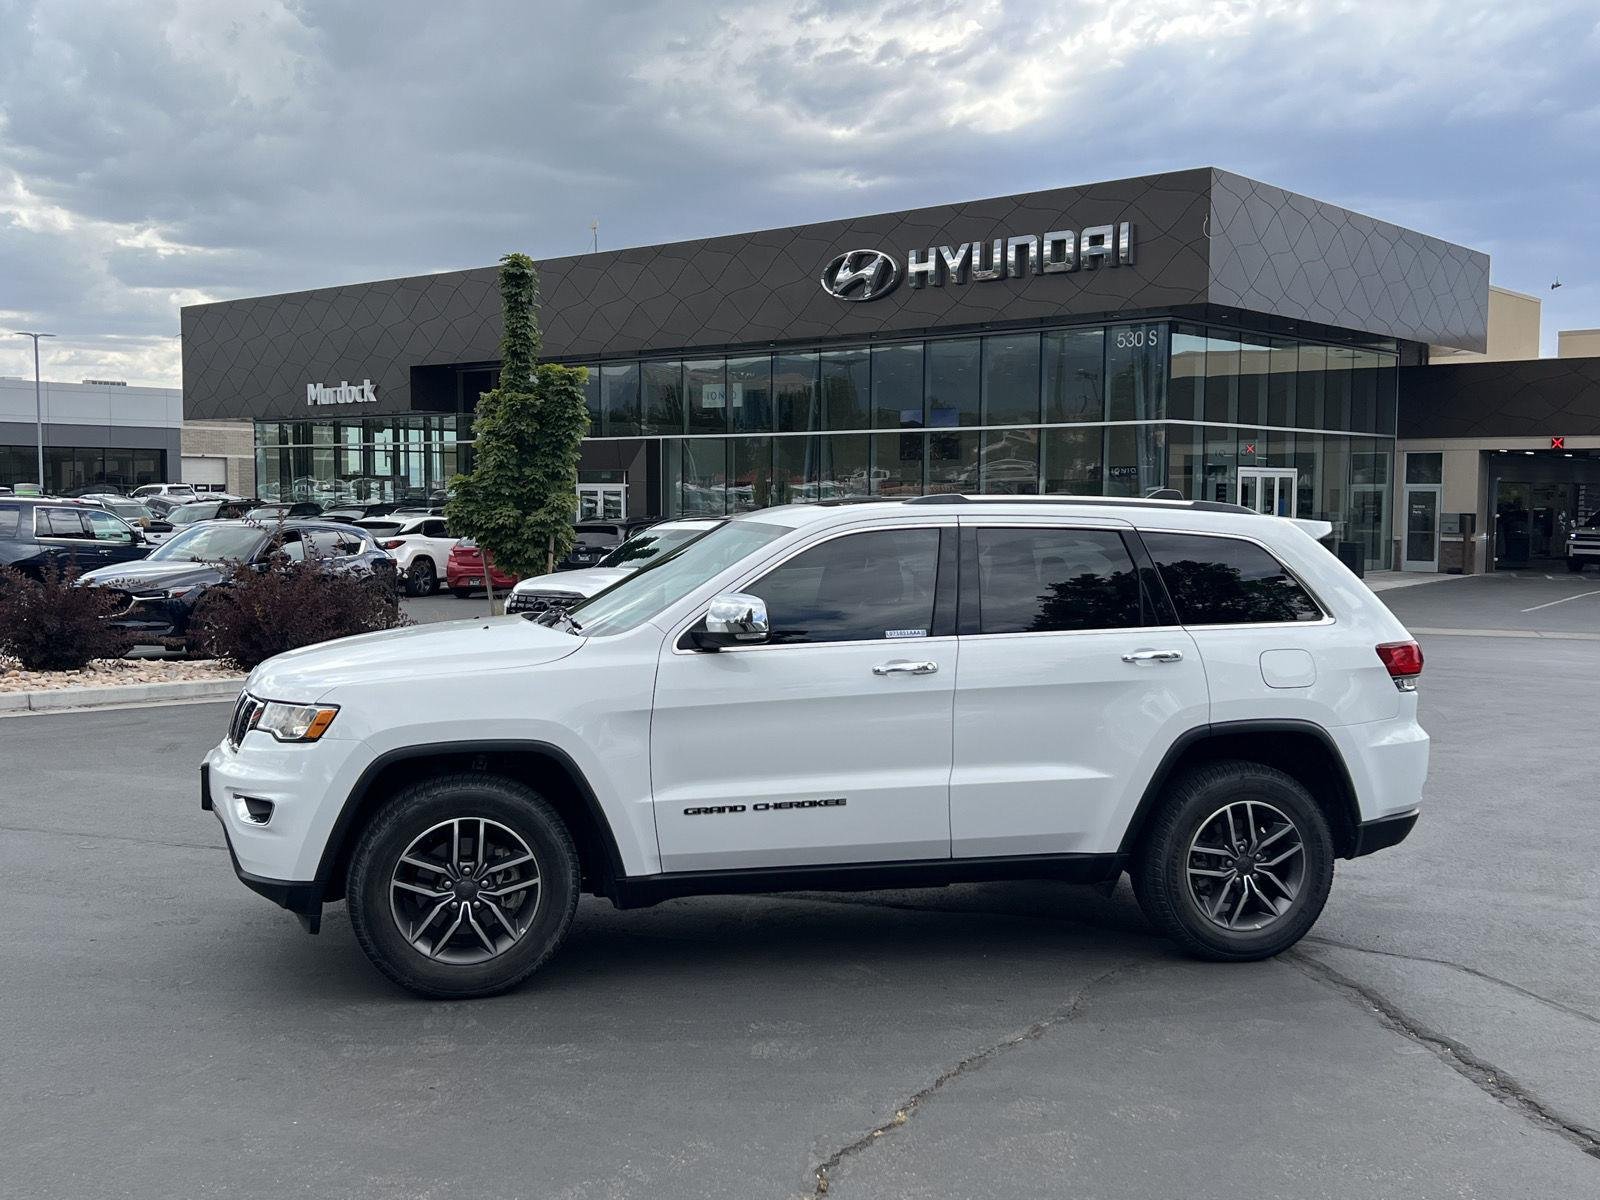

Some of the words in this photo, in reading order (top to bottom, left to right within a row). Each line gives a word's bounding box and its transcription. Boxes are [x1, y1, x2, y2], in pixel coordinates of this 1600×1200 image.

[908, 221, 1134, 288] HYUNDAI
[1117, 331, 1144, 348] 530
[1148, 330, 1157, 346] S
[307, 379, 377, 406] Murdock
[683, 804, 746, 816] GRAND
[752, 798, 847, 812] CHEROKEE
